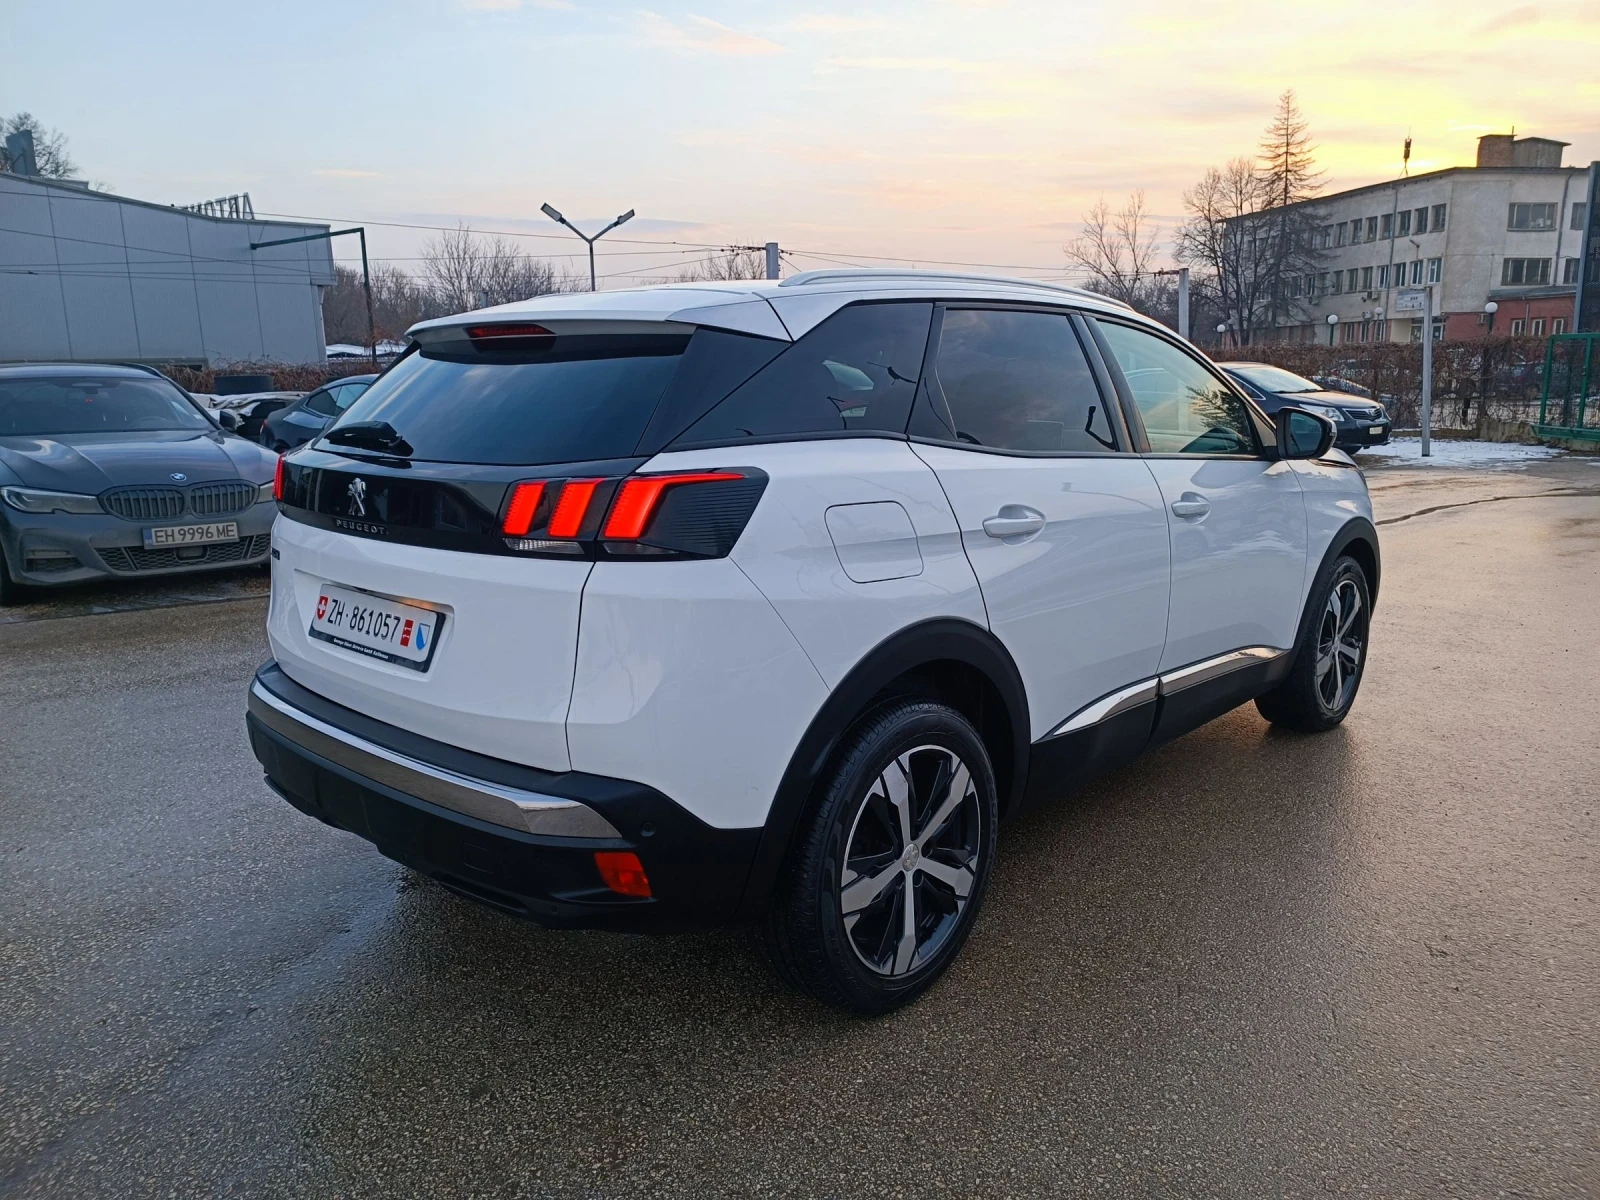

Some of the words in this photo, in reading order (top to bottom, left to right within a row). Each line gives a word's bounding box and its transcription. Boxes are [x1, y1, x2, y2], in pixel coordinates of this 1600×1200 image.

[154, 529, 175, 543] EH
[178, 526, 213, 541] 9996
[216, 524, 235, 538] ME
[336, 519, 384, 535] PEUGEOT
